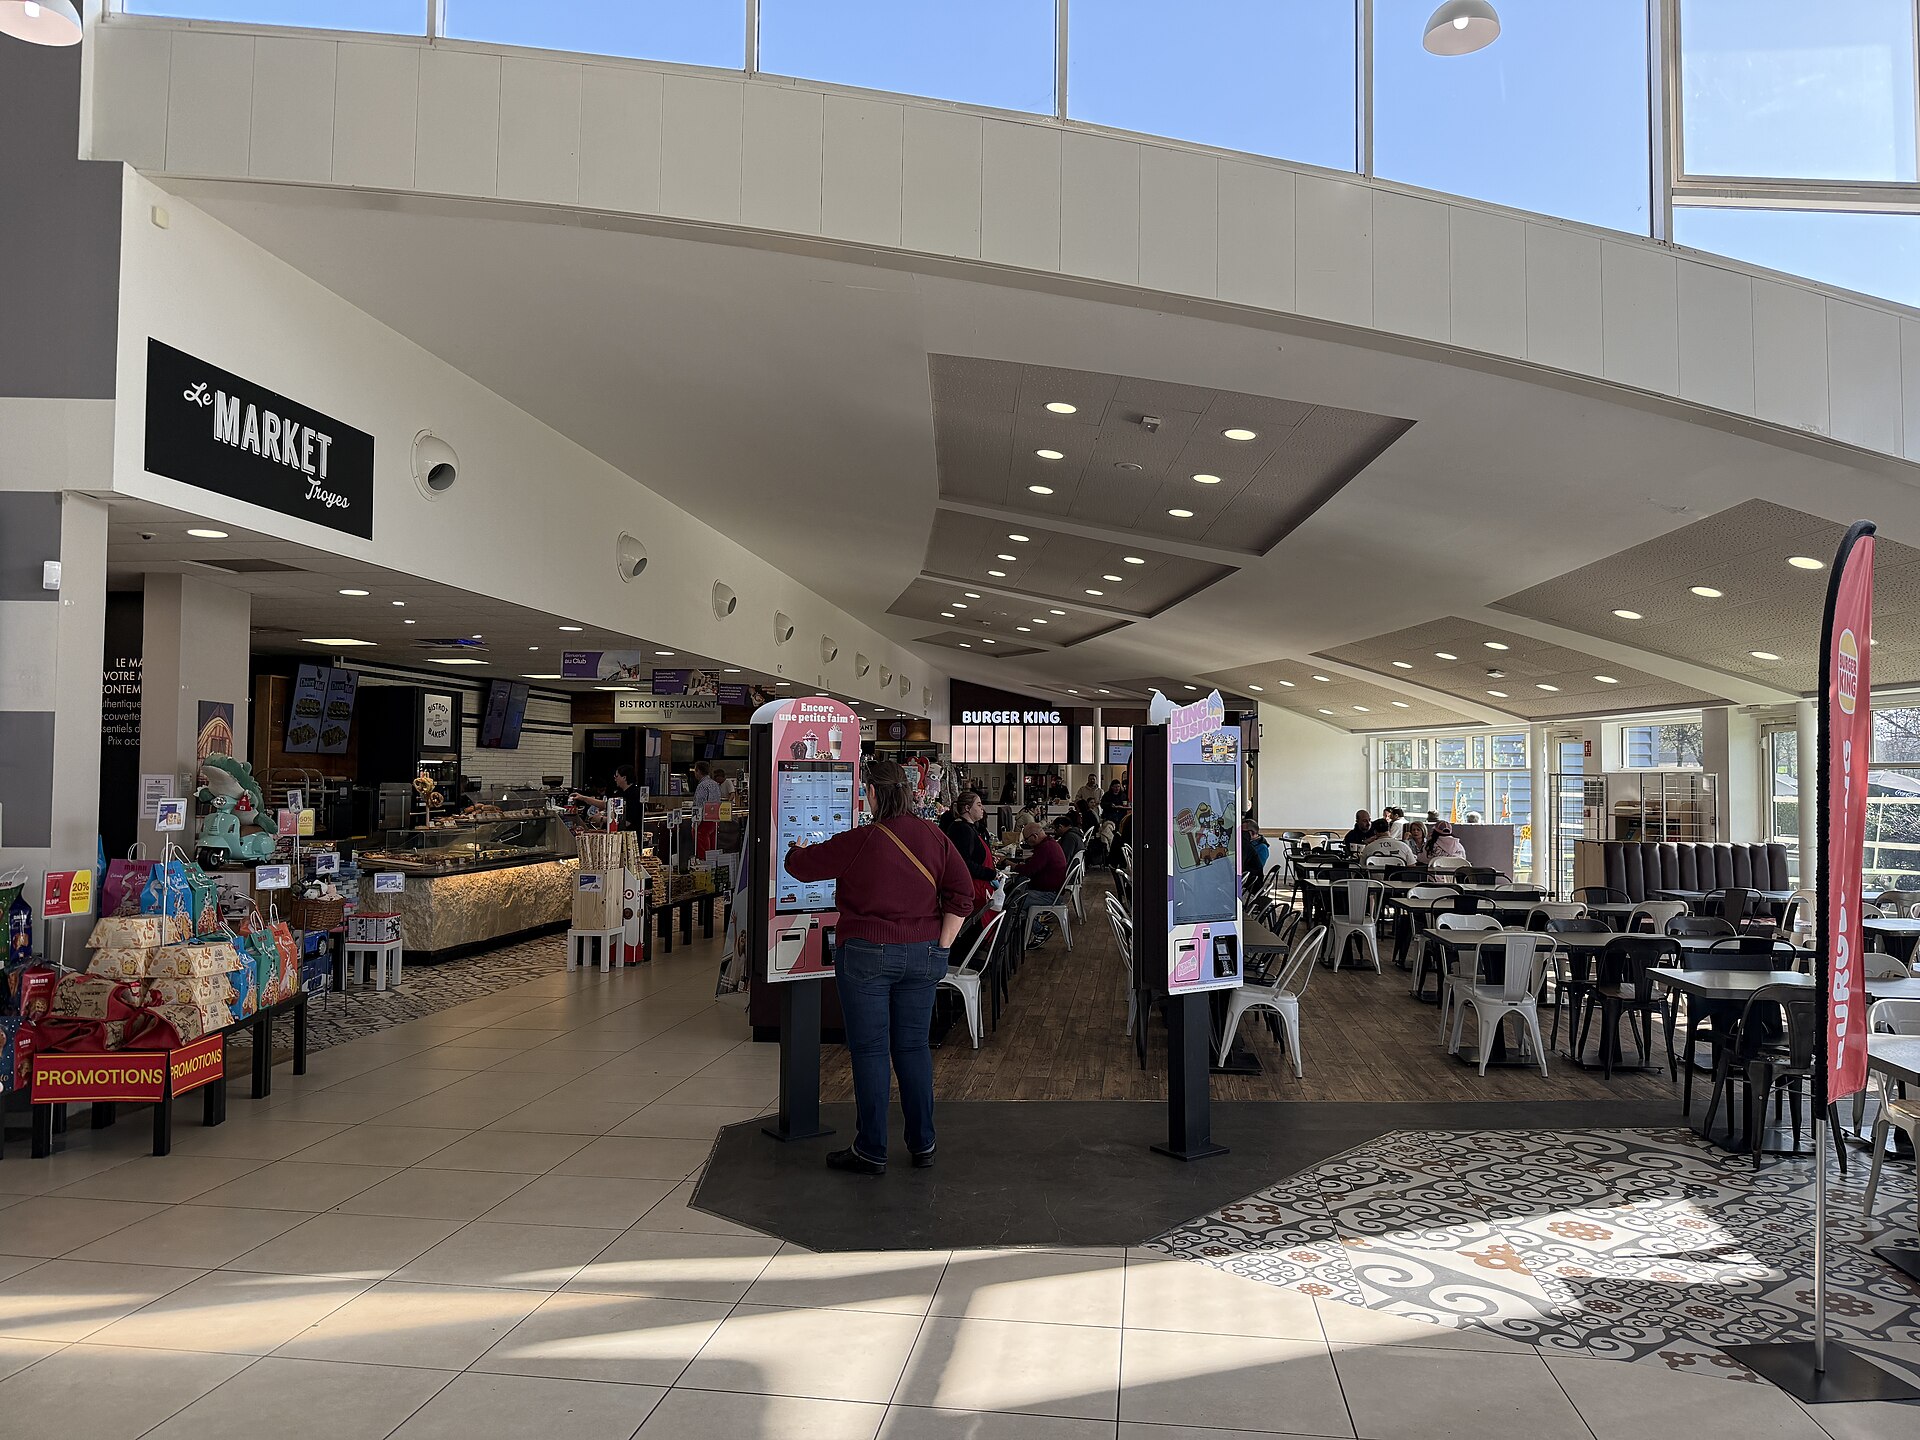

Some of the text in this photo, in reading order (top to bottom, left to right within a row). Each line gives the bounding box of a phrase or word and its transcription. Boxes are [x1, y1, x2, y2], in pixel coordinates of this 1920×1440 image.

[183, 382, 213, 407] Le
[213, 390, 332, 480] MARKET
[305, 476, 350, 508] Troyes
[116, 658, 126, 668] LE
[1839, 653, 1857, 675] BURGER
[103, 671, 135, 681] VOTRE
[1839, 670, 1857, 697] KING
[427, 702, 449, 714] BISTROT
[619, 700, 657, 709] BISTROT
[659, 700, 717, 709] RESTAURANT
[800, 703, 835, 712] Encore
[798, 713, 826, 724] petite
[827, 713, 849, 723] faim
[849, 715, 855, 723] ?
[962, 710, 1061, 724] BURGER KING
[1171, 700, 1207, 728] KING
[427, 727, 448, 738] BAKERY
[1171, 716, 1222, 743] FUSION
[72, 881, 89, 892] 20%
[170, 1048, 222, 1080] PROMOTIONS
[36, 1068, 163, 1086] PROMOTIONS
